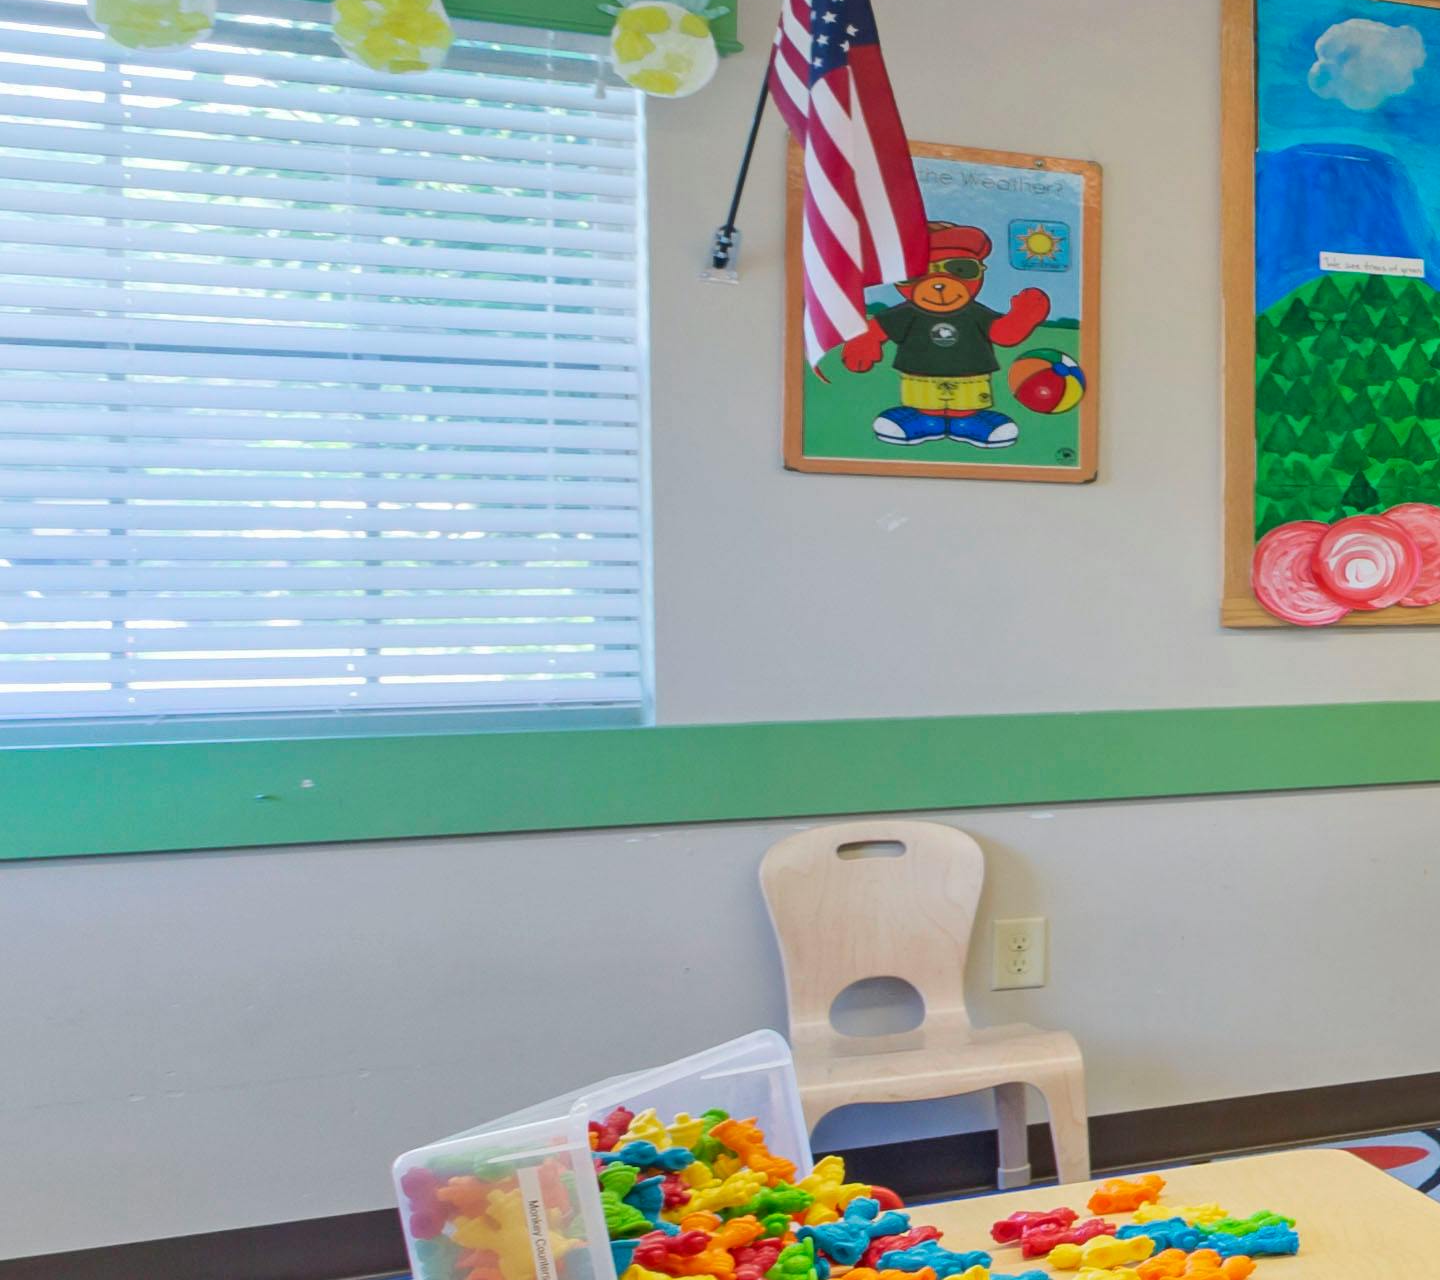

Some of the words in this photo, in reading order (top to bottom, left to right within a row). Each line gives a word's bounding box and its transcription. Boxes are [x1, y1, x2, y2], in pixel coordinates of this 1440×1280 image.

[918, 169, 954, 185] the
[960, 170, 1064, 195] Weather?
[1323, 256, 1341, 267] We
[1363, 261, 1386, 271] trees
[1388, 263, 1398, 271] of
[1400, 267, 1422, 276] green
[528, 1199, 544, 1237] Monkey
[535, 1237, 552, 1280] Counters
